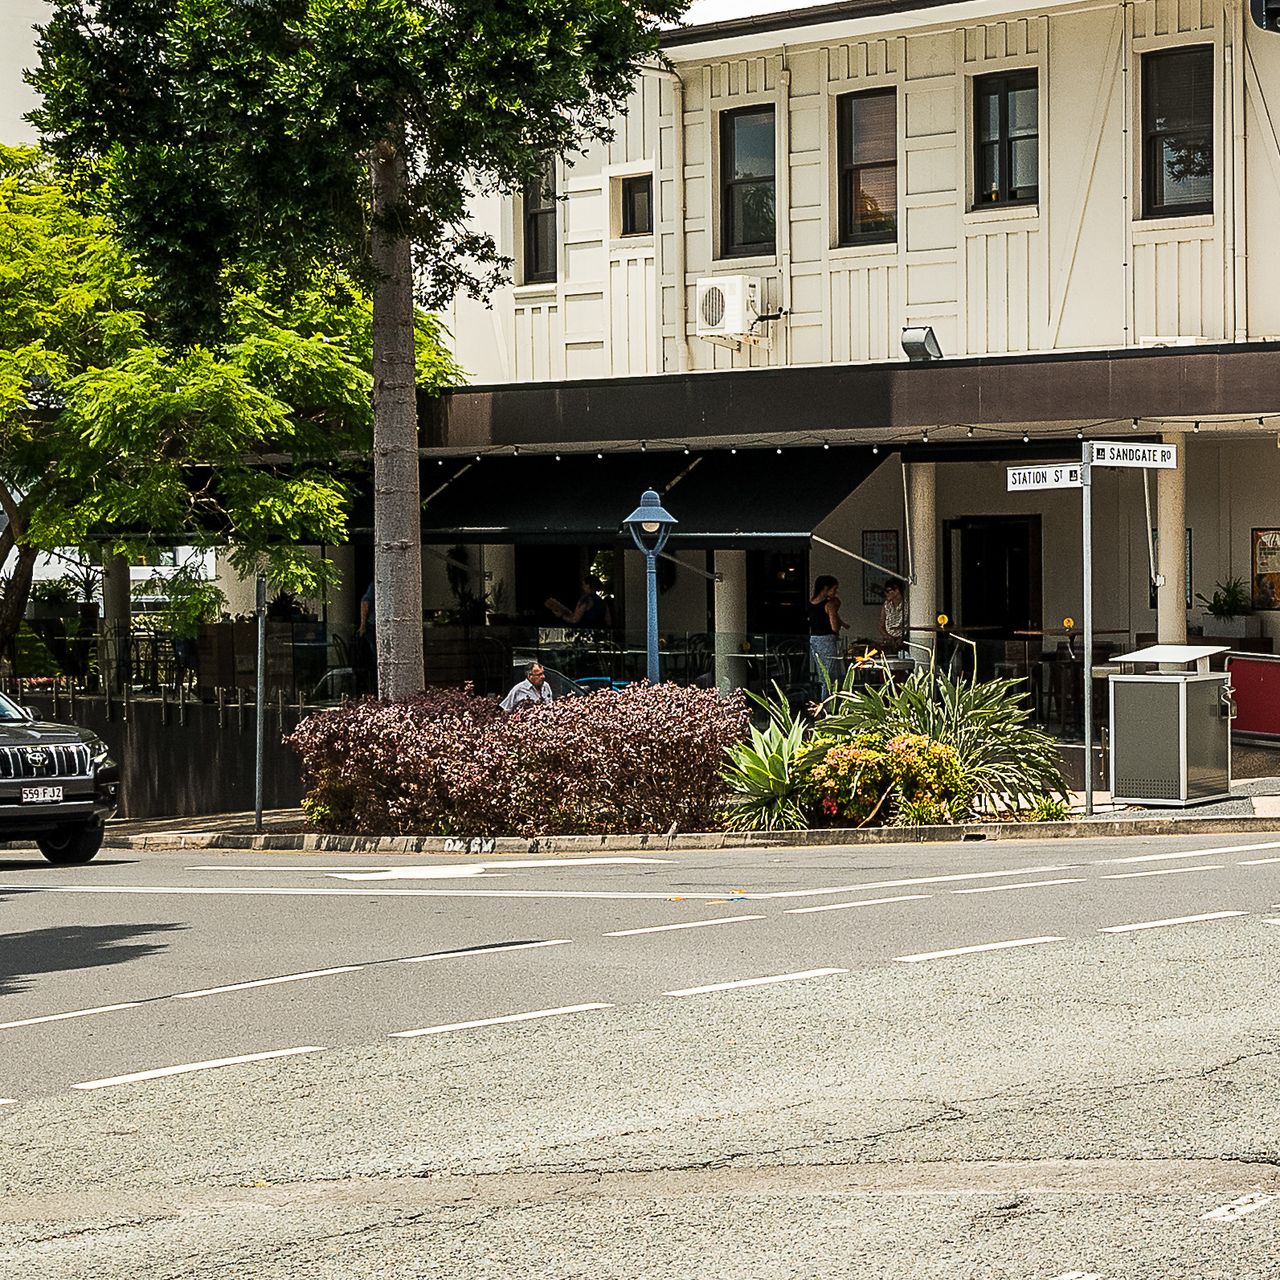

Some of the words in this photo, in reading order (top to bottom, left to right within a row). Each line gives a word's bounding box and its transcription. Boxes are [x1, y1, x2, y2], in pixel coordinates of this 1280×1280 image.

[1110, 447, 1157, 462] SANDGATE
[1161, 450, 1171, 462] RD
[1011, 471, 1047, 485] STATION
[1054, 470, 1063, 483] ST
[22, 789, 39, 799] 559
